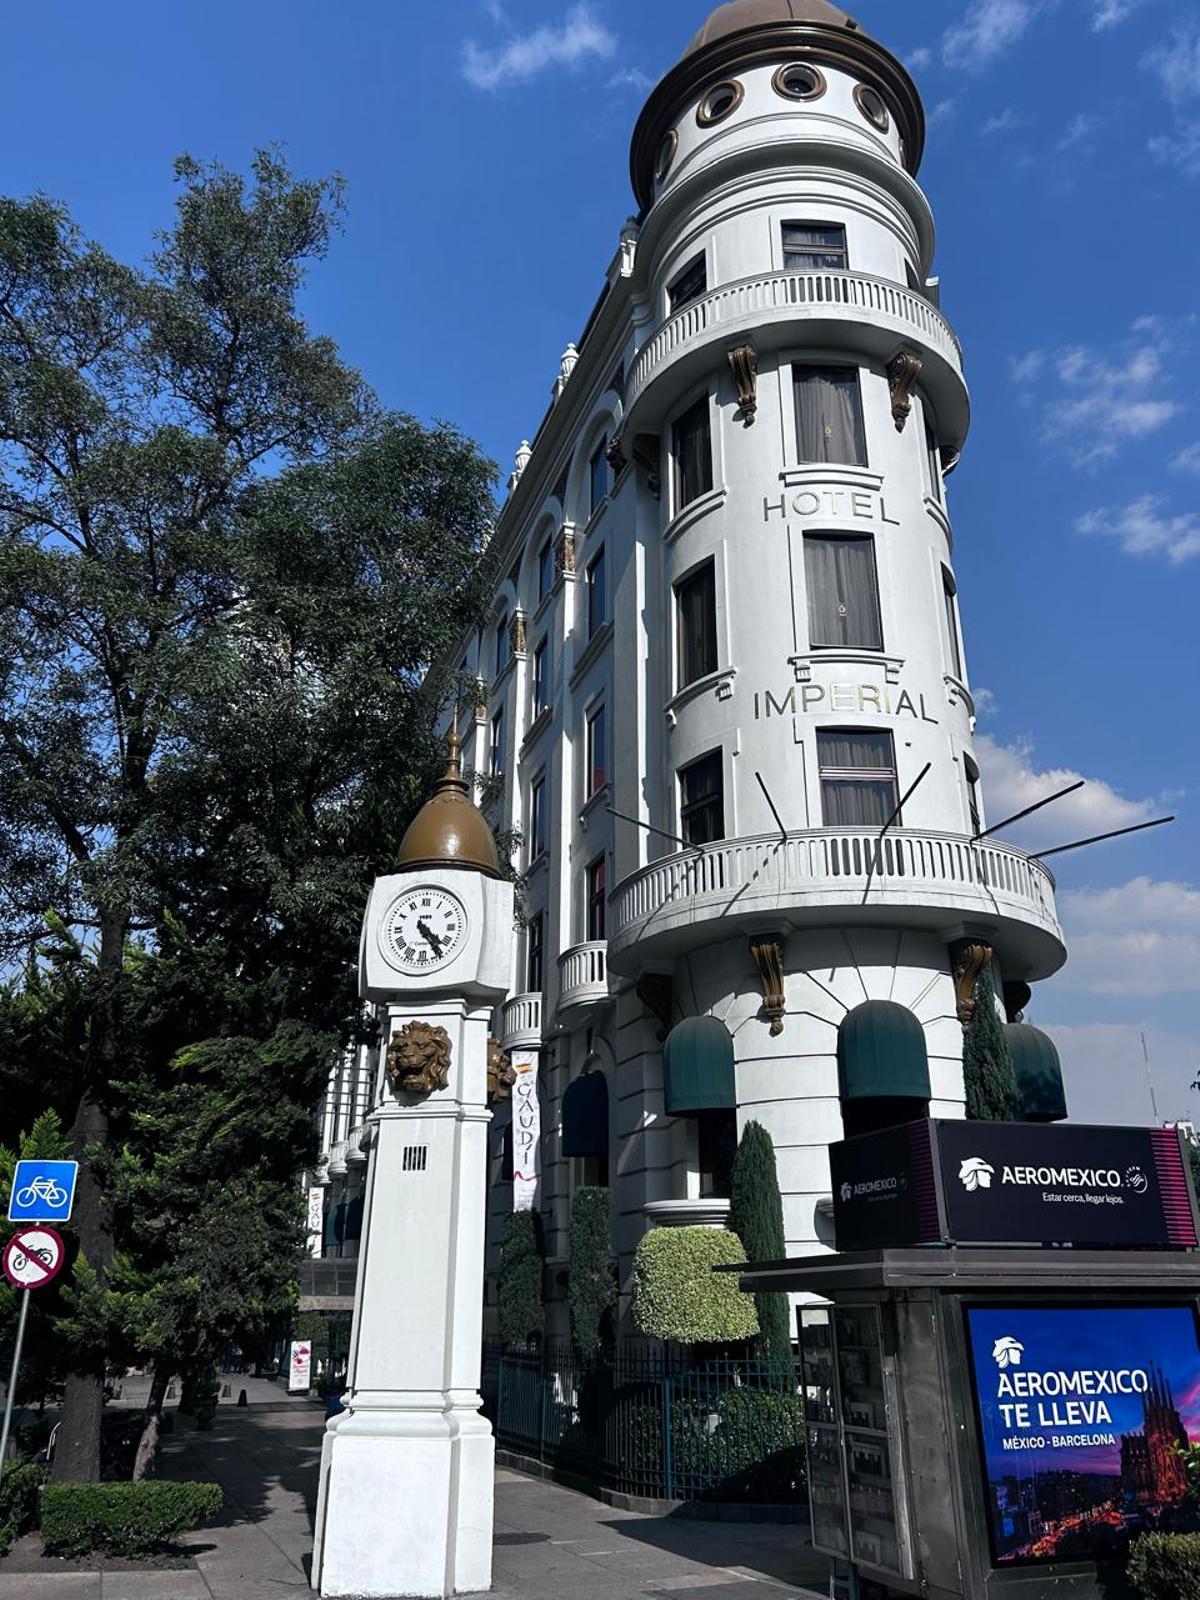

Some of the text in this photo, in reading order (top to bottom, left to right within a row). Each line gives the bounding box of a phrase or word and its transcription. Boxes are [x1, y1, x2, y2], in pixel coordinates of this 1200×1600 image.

[763, 491, 900, 526] HOTEL
[753, 682, 939, 725] IMPERIAL
[517, 1083, 534, 1165] GAUDÍ
[854, 1177, 897, 1195] AEROMEXICO
[1001, 1166, 1121, 1188] AEROMEXICO
[1042, 1192, 1062, 1202] Estar
[1085, 1193, 1105, 1205] llegar
[997, 1369, 1149, 1398] AEROMEXICO
[998, 1400, 1112, 1428] TE LLEVA
[1002, 1435, 1045, 1450] MÉXICO
[1053, 1433, 1116, 1448] BARCELONA
